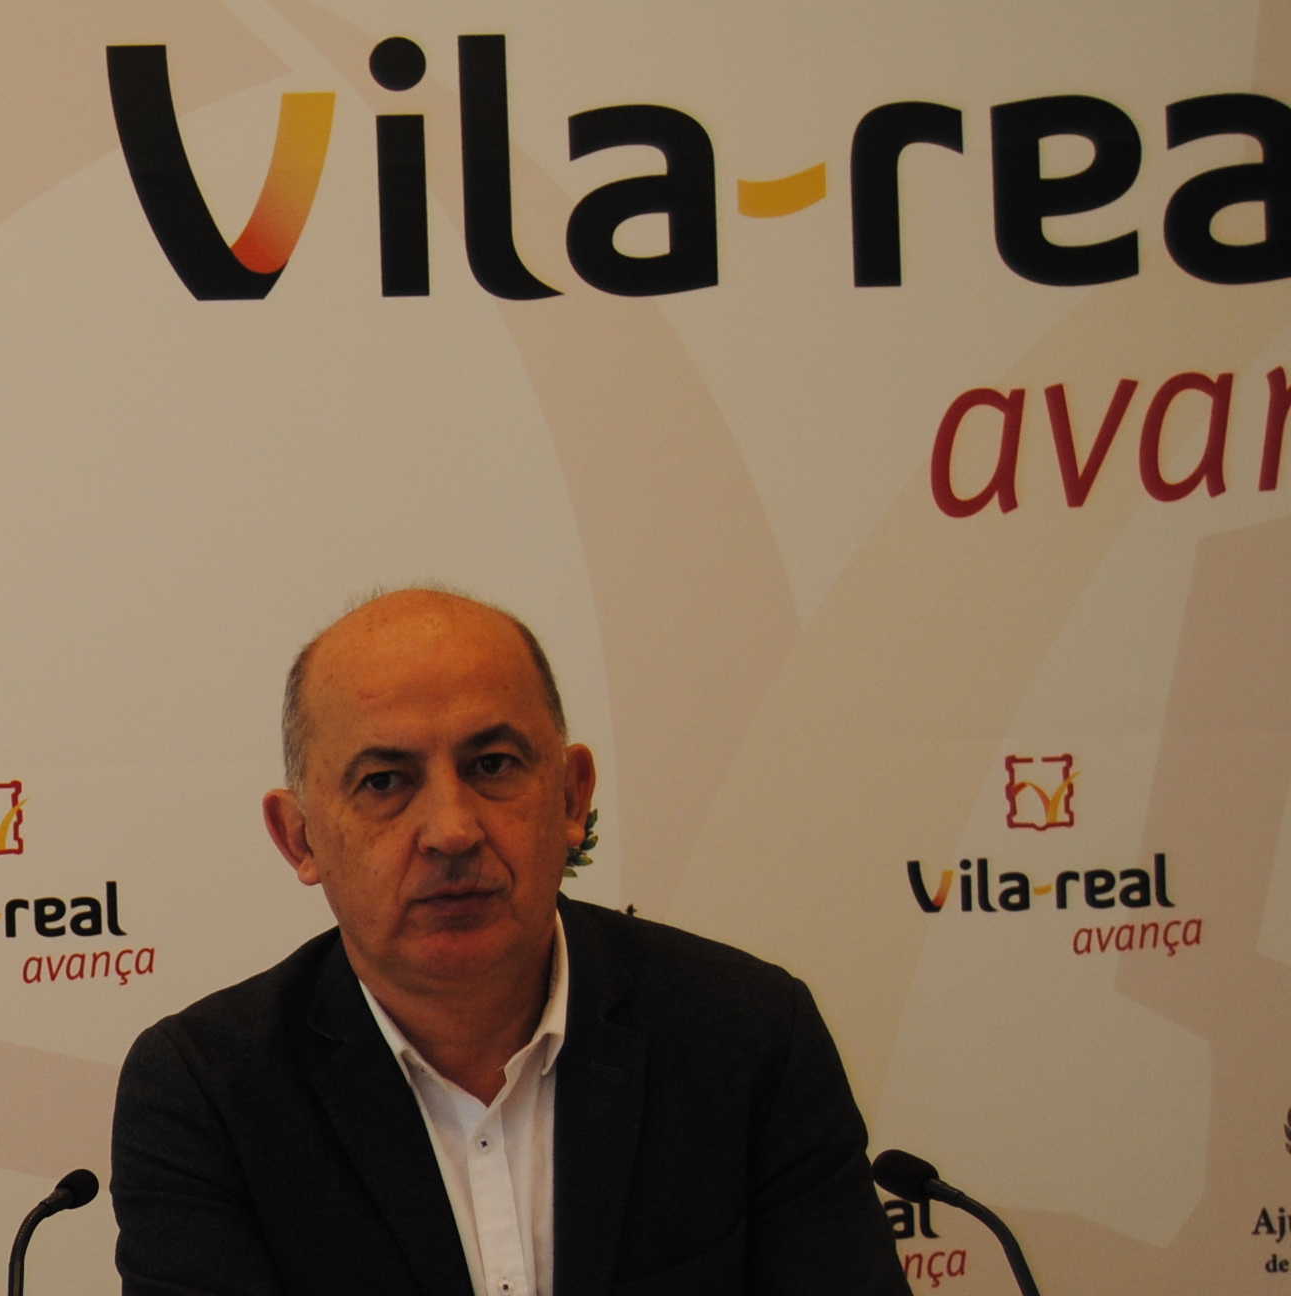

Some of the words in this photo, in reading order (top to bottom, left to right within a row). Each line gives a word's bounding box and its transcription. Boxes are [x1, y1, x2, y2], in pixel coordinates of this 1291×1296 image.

[906, 853, 1176, 913] Vila-real
[1072, 917, 1203, 957] avança
[22, 946, 156, 986] avança
[1251, 1206, 1291, 1243] Aj
[1264, 1254, 1290, 1273] de
